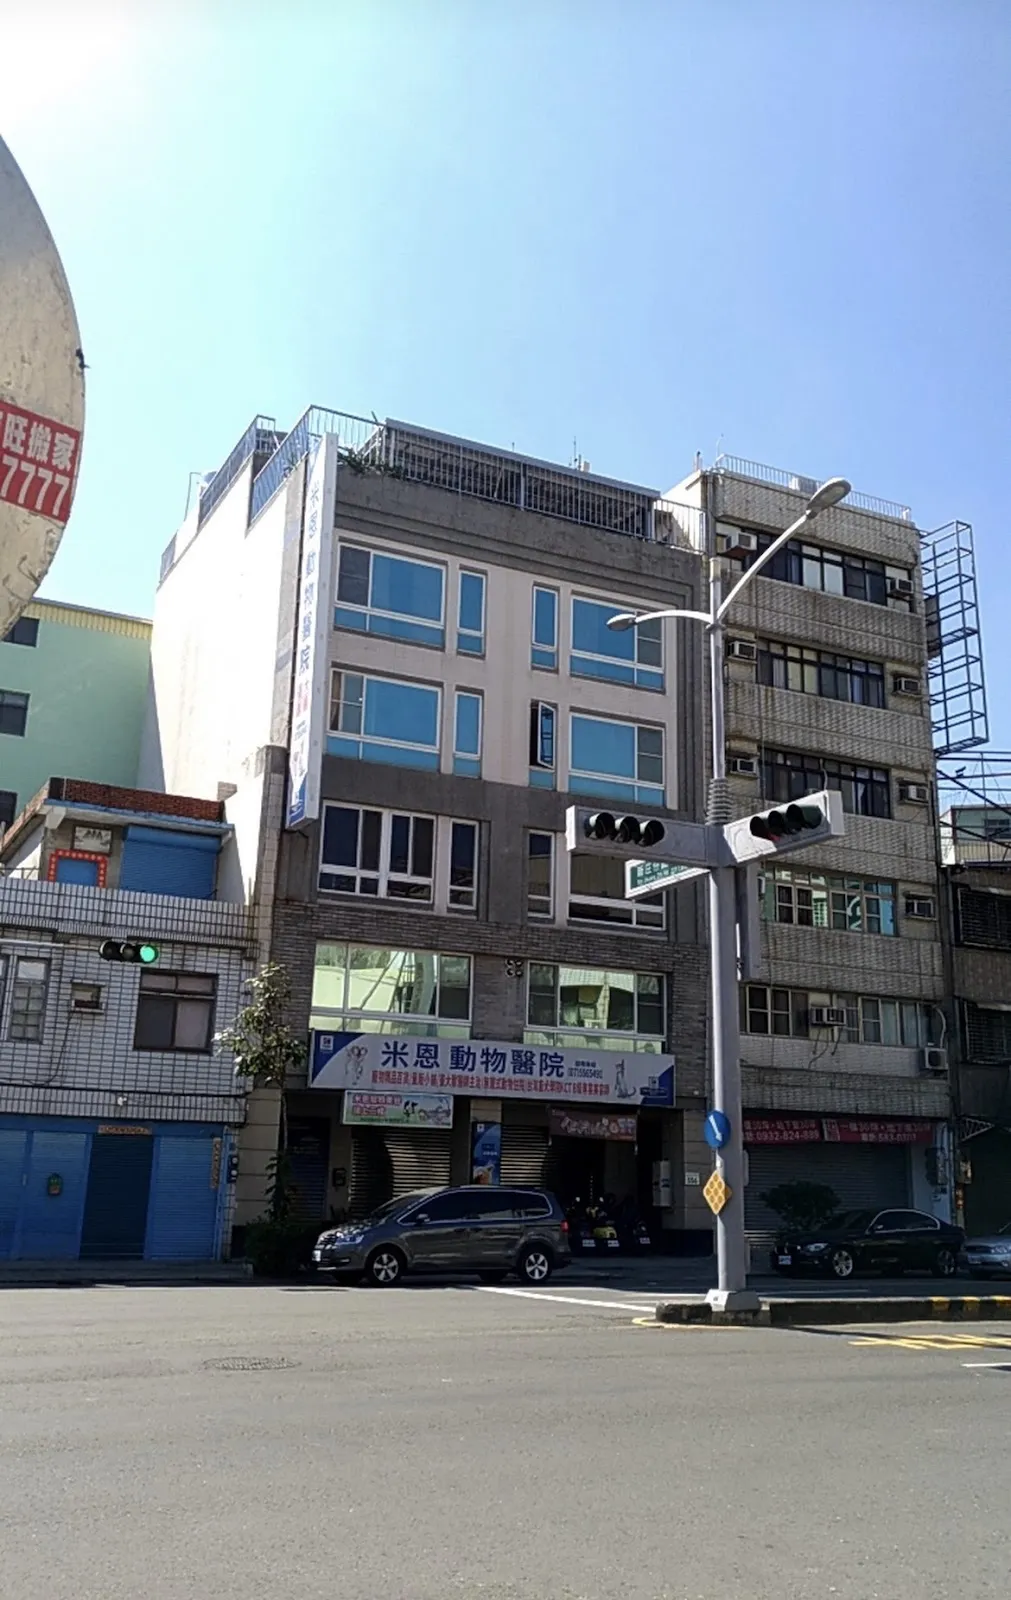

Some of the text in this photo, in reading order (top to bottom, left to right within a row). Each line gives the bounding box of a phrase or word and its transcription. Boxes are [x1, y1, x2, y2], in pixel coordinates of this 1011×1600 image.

[381, 1039, 565, 1079] 米恩動物醫院
